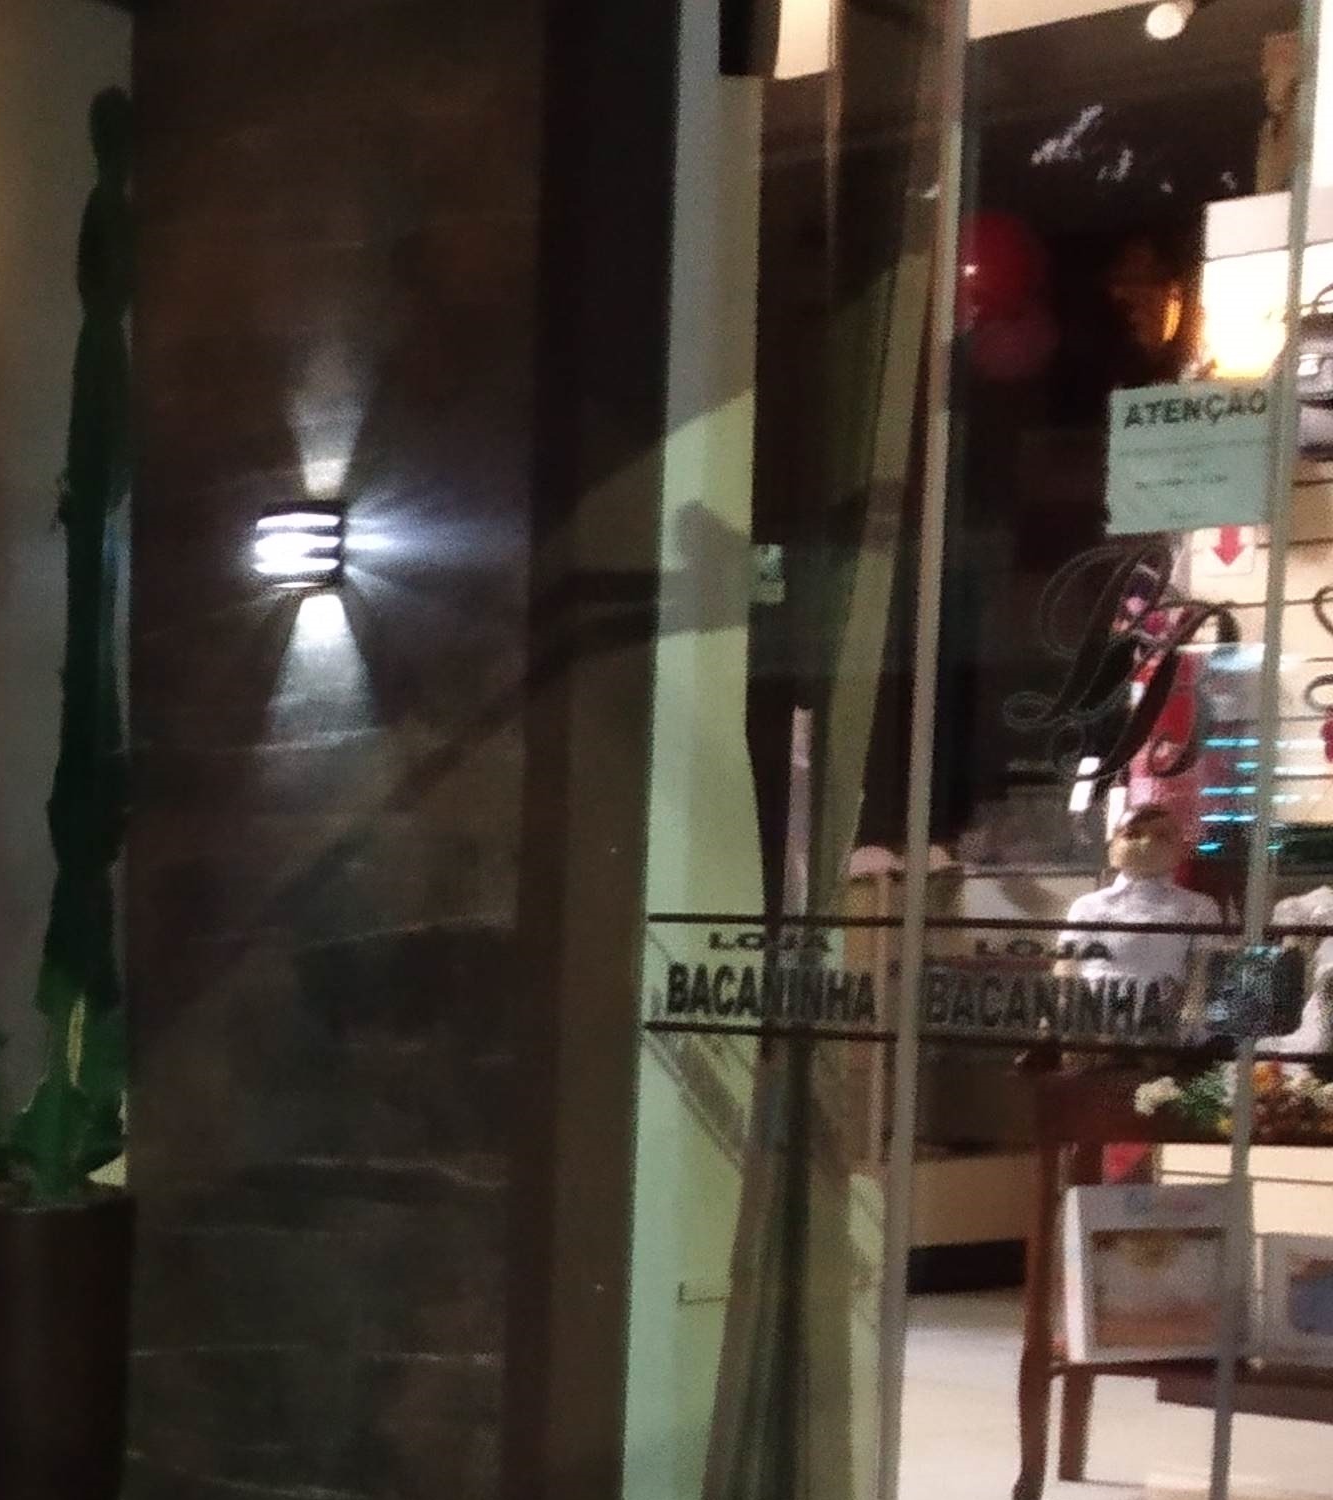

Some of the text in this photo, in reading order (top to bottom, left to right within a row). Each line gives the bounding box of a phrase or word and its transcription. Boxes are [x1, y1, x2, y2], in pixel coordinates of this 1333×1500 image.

[707, 930, 834, 953] LOJA
[974, 938, 1114, 961] LOJA
[666, 960, 877, 1024] BACANINHA
[923, 965, 1171, 1038] BACANINHA
